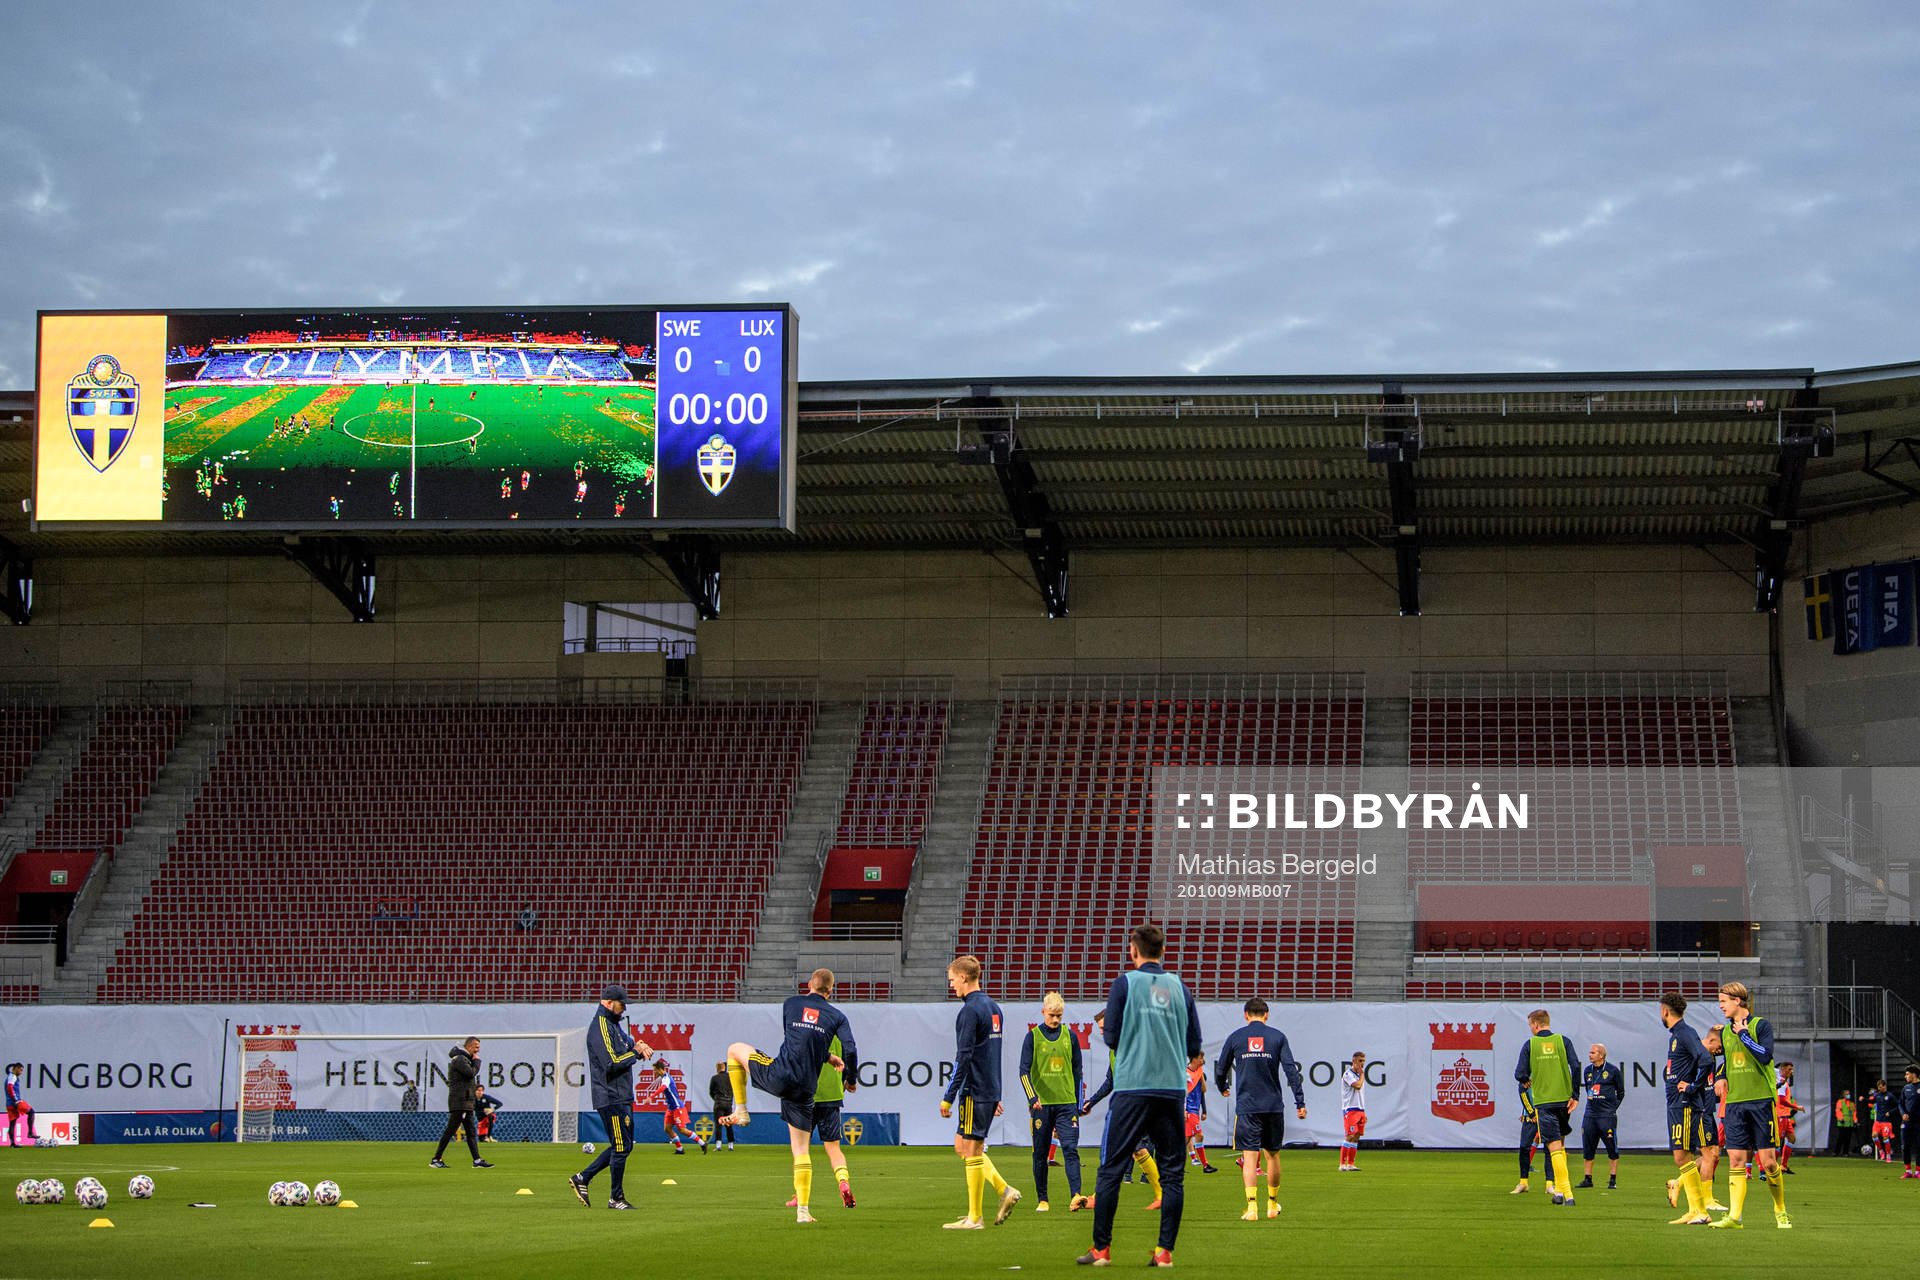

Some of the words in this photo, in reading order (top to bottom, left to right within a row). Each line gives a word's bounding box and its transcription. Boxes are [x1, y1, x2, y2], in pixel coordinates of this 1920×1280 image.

[663, 320, 701, 337] SWE
[740, 319, 775, 337] LUX
[243, 350, 599, 379] OLYMPIA
[675, 346, 692, 373] 0
[744, 346, 761, 373] 0
[669, 393, 768, 425] 00:00
[1845, 571, 1859, 647] UEFA
[1884, 575, 1898, 633] FIFA
[793, 1021, 814, 1029] SVENSKA
[814, 1024, 825, 1034] SPEL
[326, 1060, 586, 1088] HELSINBORG
[959, 1105, 965, 1121] 8
[123, 1127, 151, 1136] ALLA
[154, 1126, 169, 1136] ÄR
[172, 1127, 205, 1136] OLIKA
[287, 1126, 309, 1135] BRA
[1671, 1124, 1682, 1139] 10
[1768, 1121, 1774, 1137] 7
